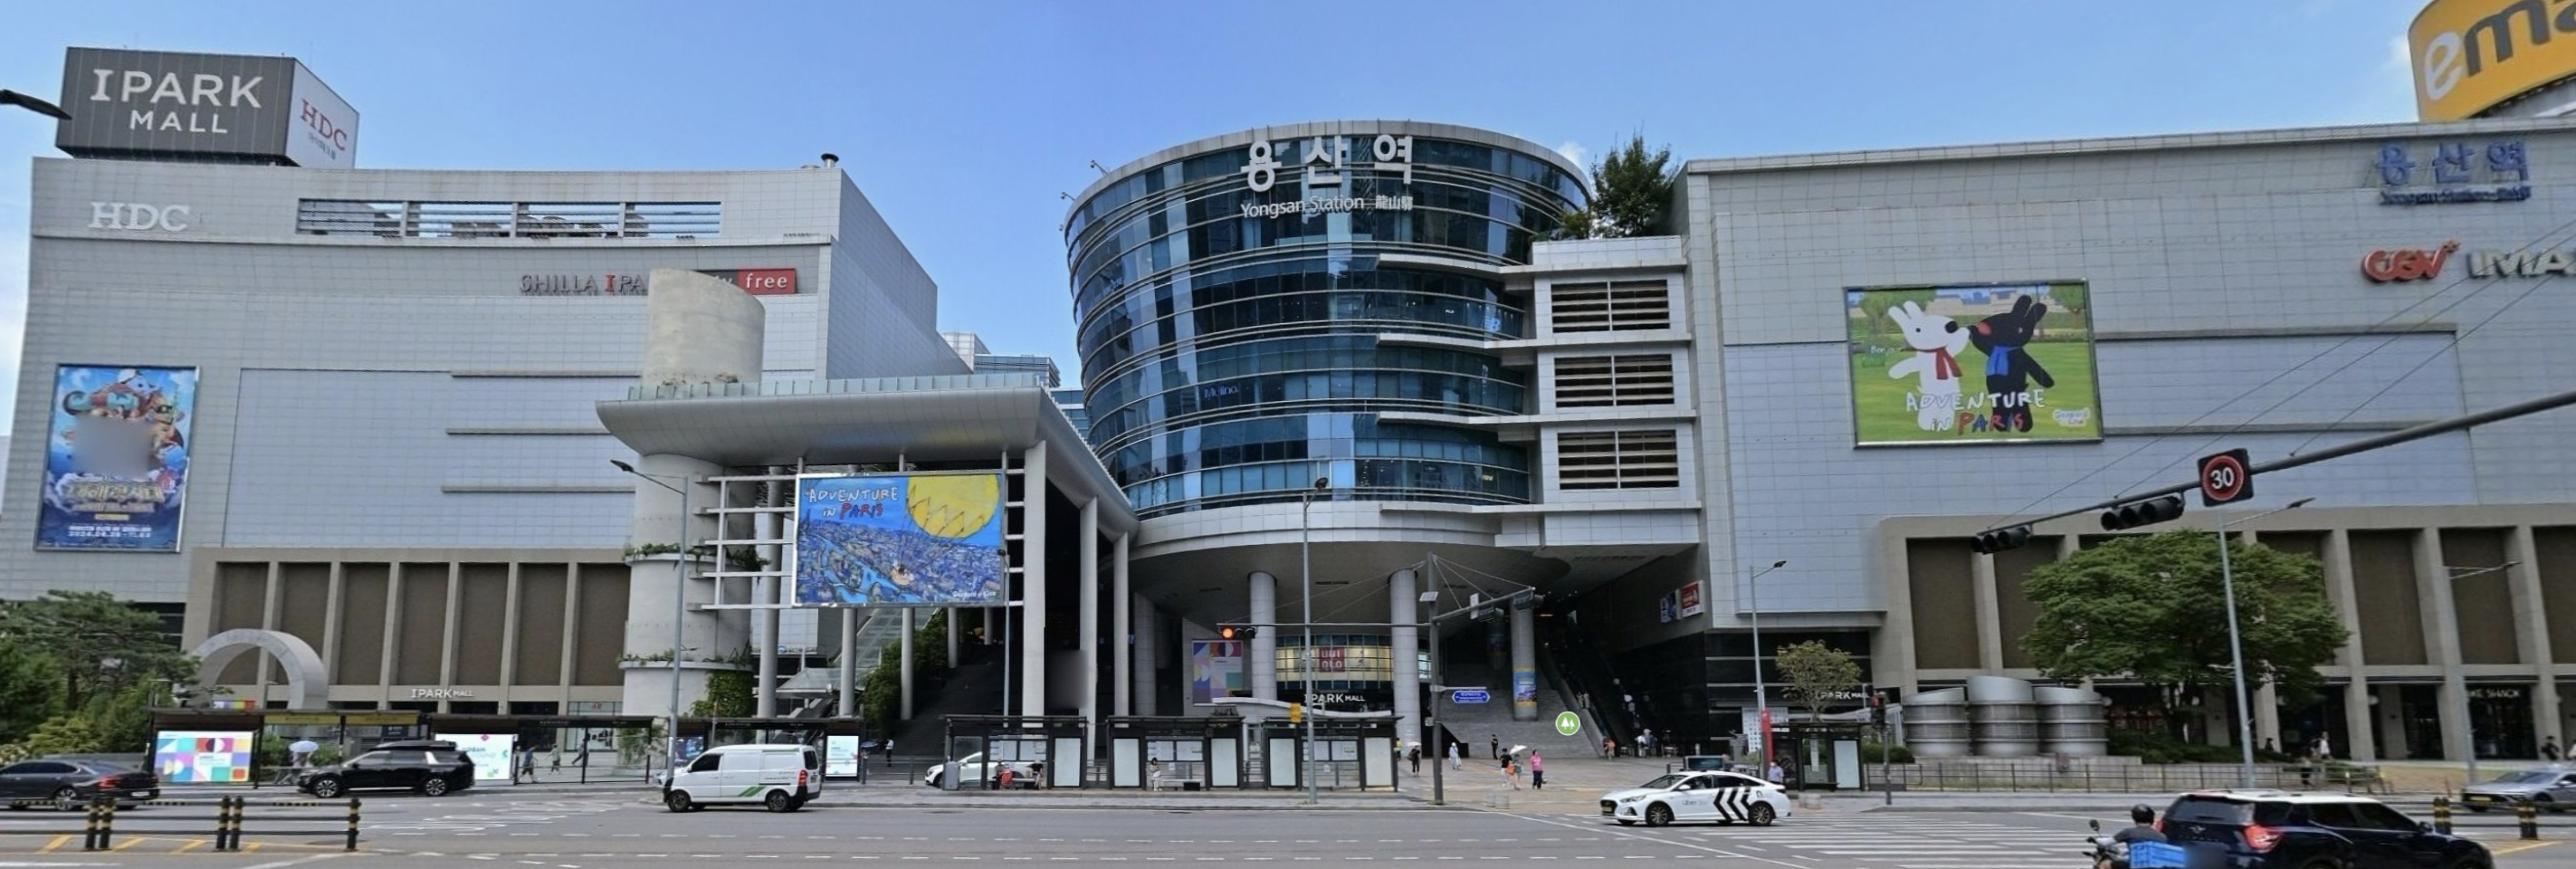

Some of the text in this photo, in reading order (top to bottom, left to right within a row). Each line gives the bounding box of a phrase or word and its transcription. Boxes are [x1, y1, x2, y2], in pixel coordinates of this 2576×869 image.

[91, 69, 263, 108] IPARK
[129, 110, 228, 134] MALL
[301, 99, 347, 151] HDC
[89, 202, 190, 232] HDC
[1241, 197, 1305, 219] Yongsan
[1309, 193, 1364, 213] Station
[2363, 239, 2576, 282] CGV IMA
[520, 273, 598, 294] SHILLA
[746, 272, 787, 289] free
[1906, 389, 2045, 412] ADVENTURE
[1957, 412, 2025, 435] PARIS
[2210, 466, 2235, 490] 30
[807, 487, 898, 503] ADVENTURE
[839, 502, 883, 520] PARIS
[412, 689, 453, 698] IPARK
